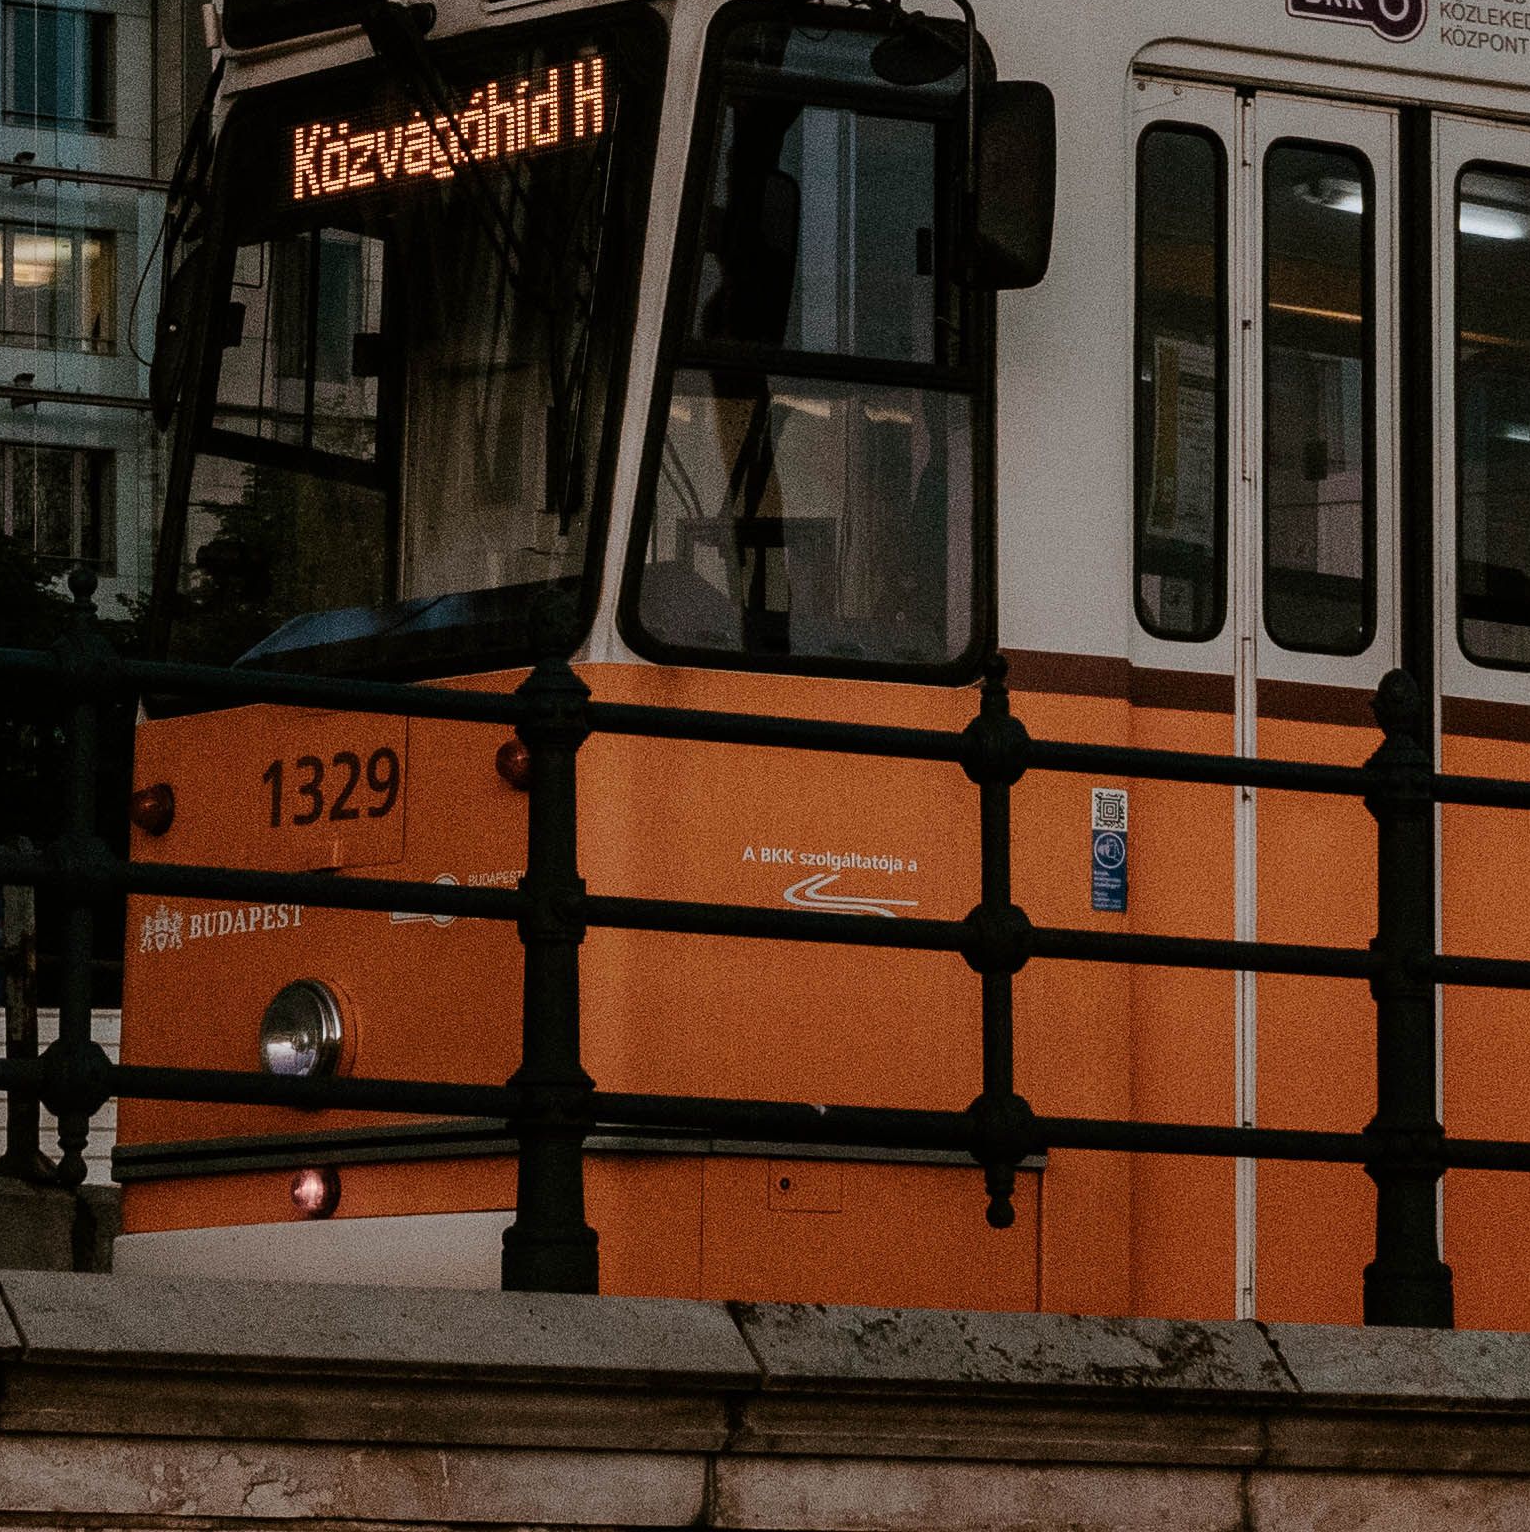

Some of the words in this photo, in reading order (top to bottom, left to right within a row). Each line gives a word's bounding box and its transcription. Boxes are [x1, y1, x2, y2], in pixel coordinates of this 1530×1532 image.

[1440, 25, 1530, 54] KÖZPONT
[573, 57, 605, 138] H
[262, 746, 401, 829] 1329
[742, 845, 757, 863] A
[760, 846, 795, 865] BKK
[799, 850, 903, 875] szolgáltatója
[907, 859, 918, 872] a
[189, 902, 306, 940] BUDAPEST
